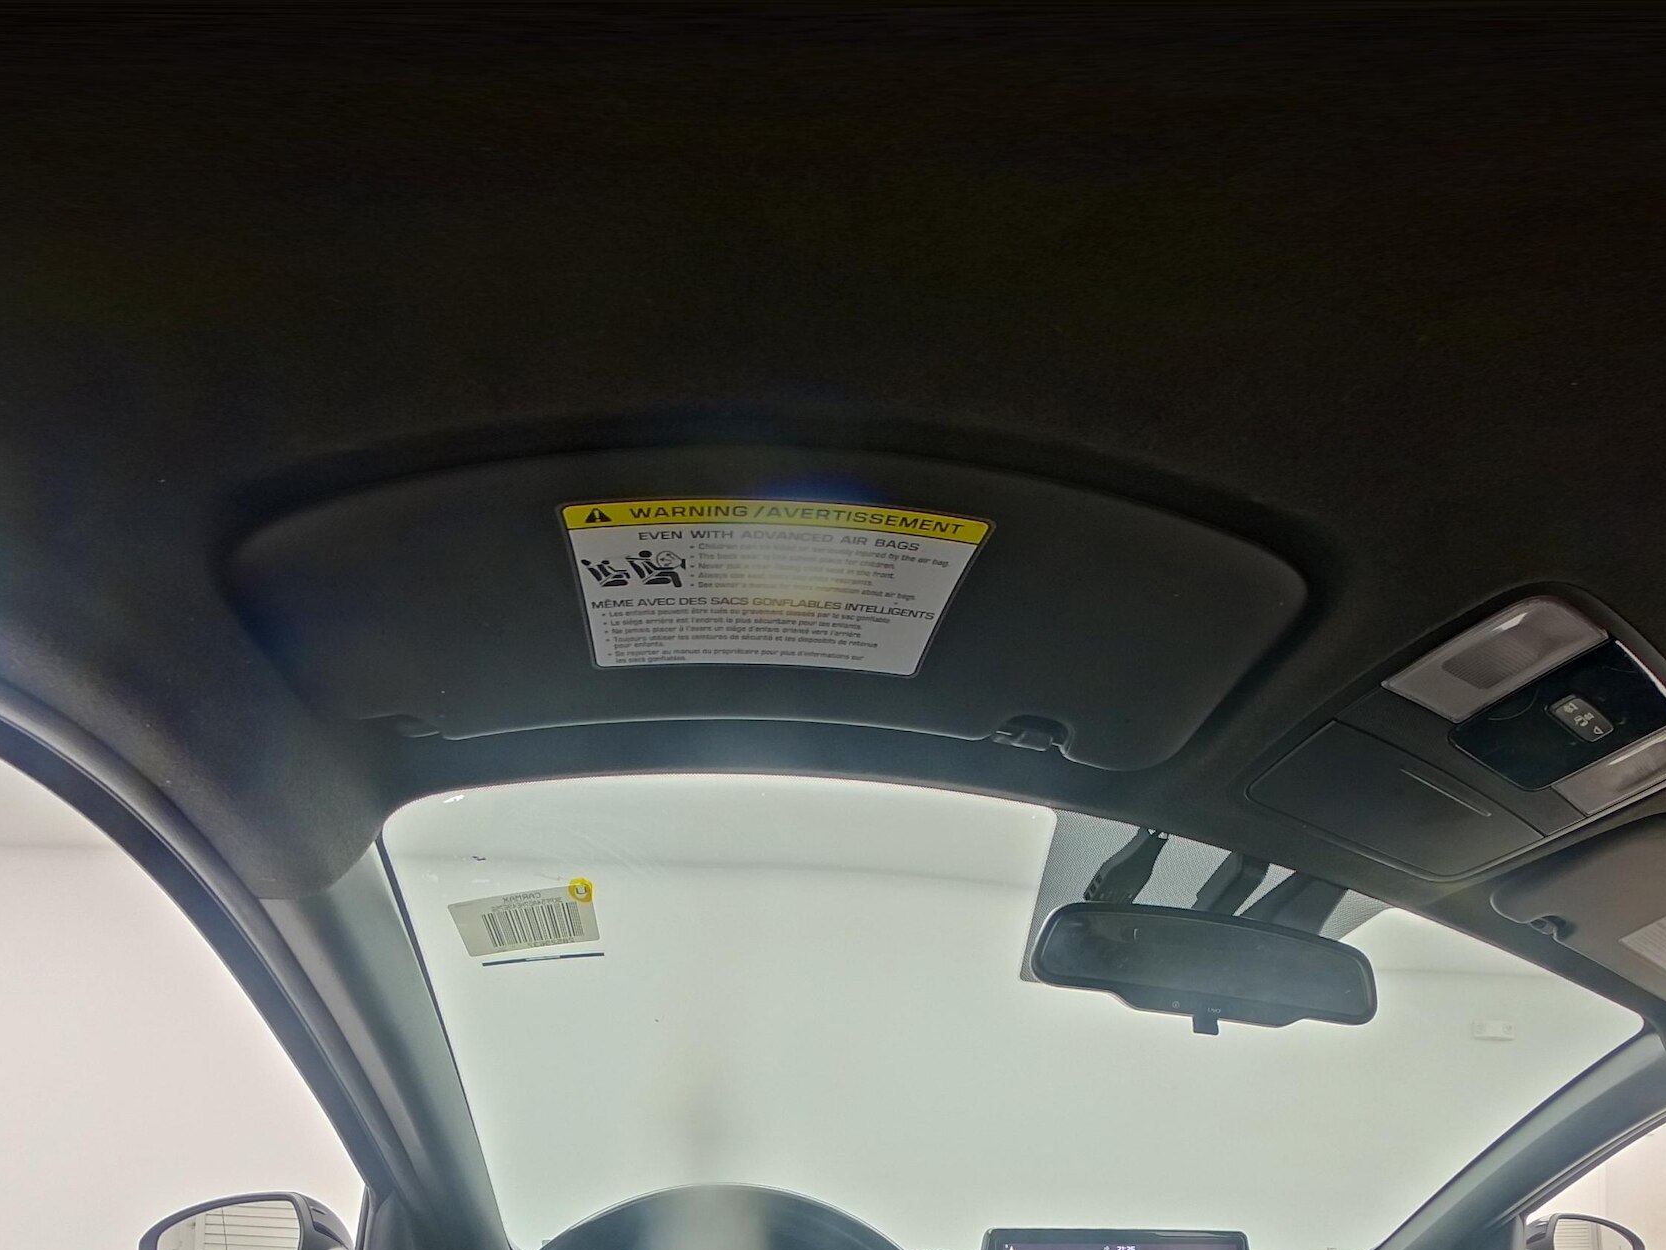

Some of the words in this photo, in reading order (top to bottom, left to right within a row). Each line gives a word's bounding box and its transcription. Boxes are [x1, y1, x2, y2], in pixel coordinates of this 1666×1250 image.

[630, 505, 748, 519] WARNING
[638, 530, 682, 540] EVEN
[690, 530, 733, 539] WITH
[741, 530, 833, 543] ADVANCED
[840, 535, 868, 546] AIR
[874, 538, 920, 551] BAGS
[591, 598, 633, 609] MÊME
[637, 597, 676, 607] AVEC
[679, 597, 707, 606] DES
[710, 597, 748, 606] SACS
[752, 597, 841, 610] GONFLABLES
[844, 602, 935, 620] INTELLIGENTS
